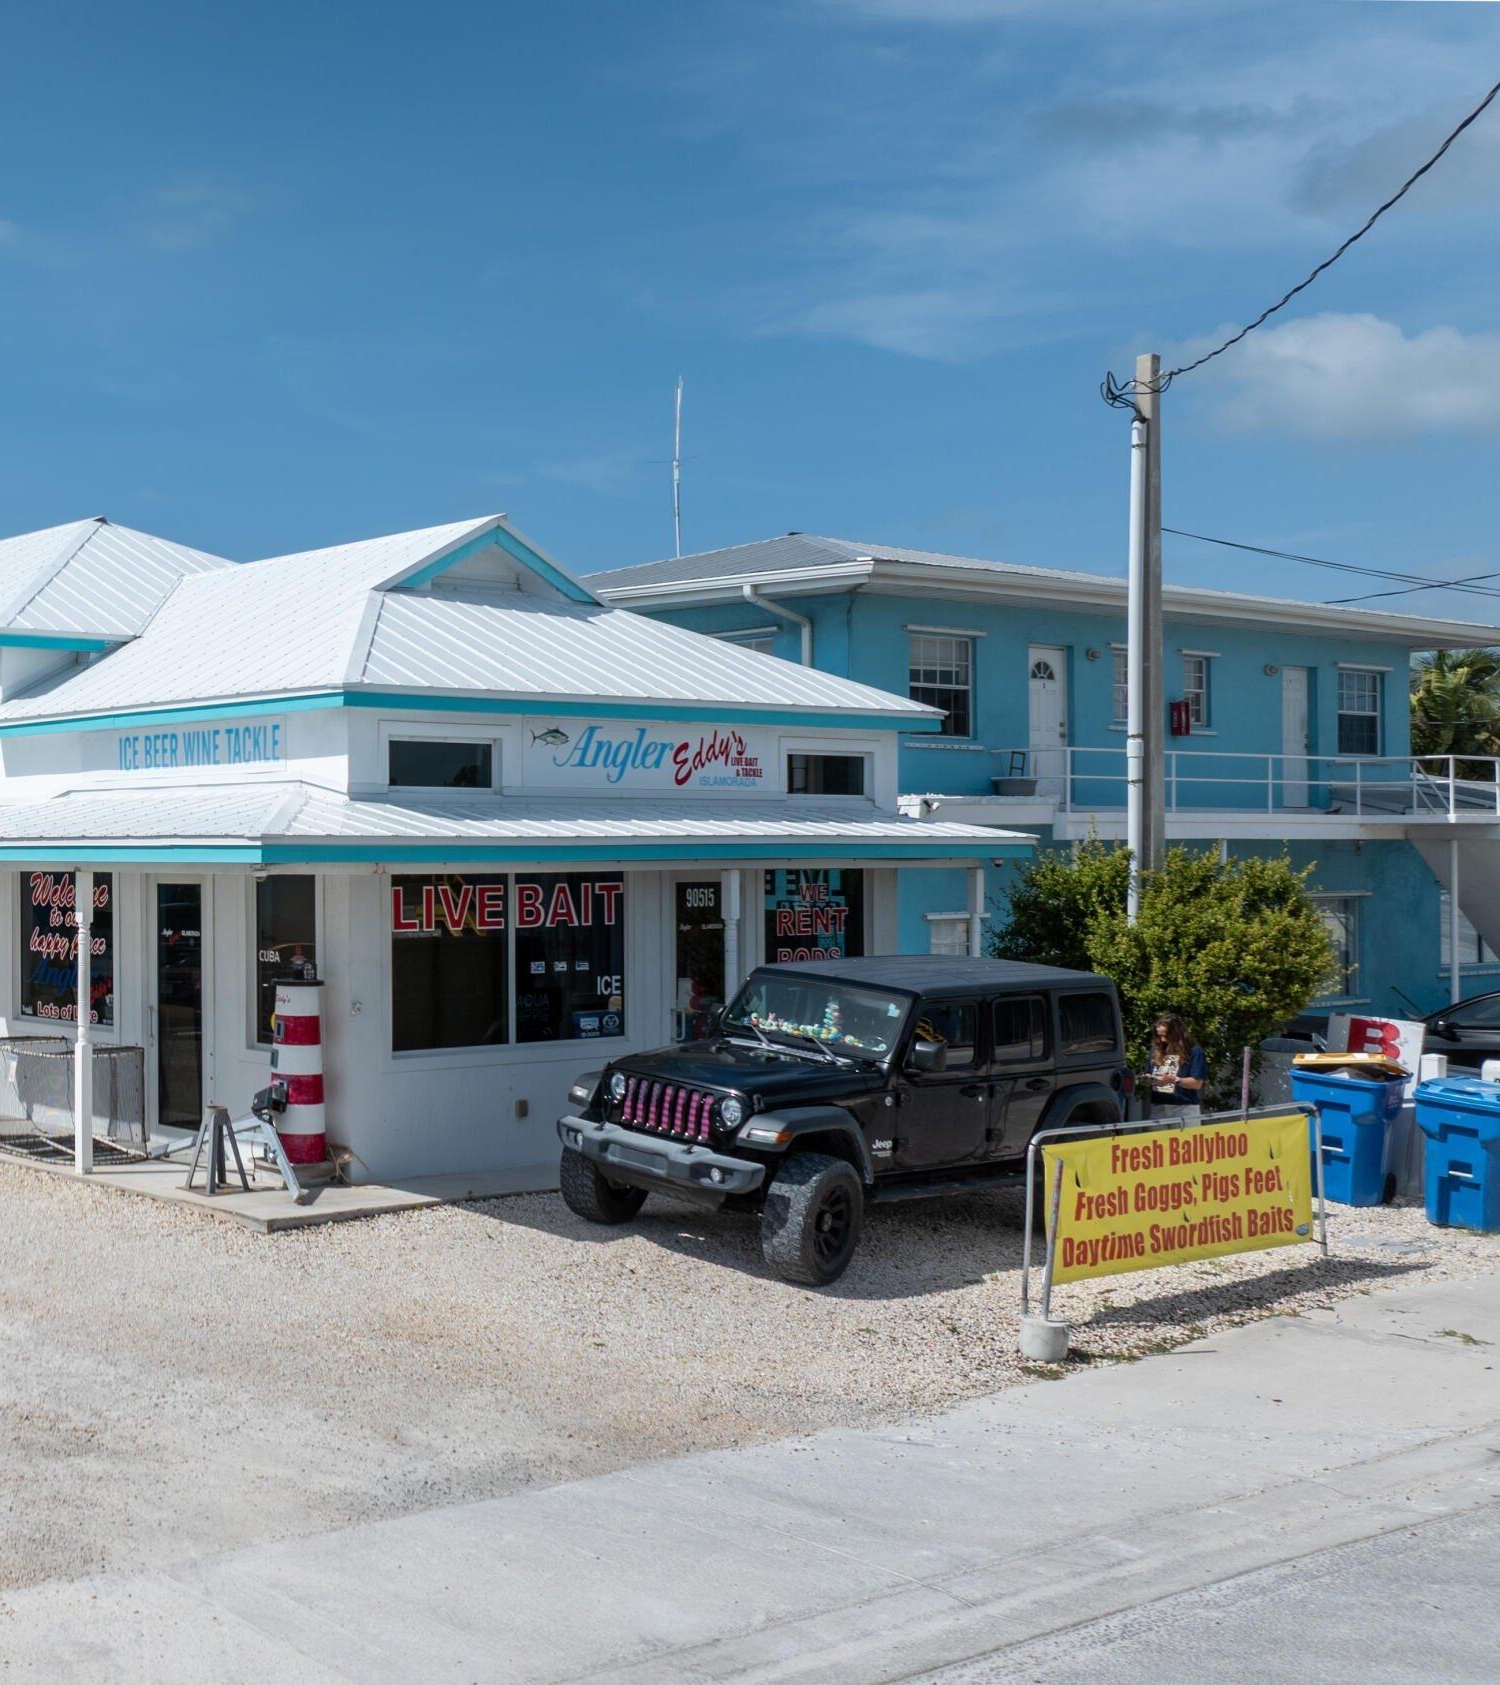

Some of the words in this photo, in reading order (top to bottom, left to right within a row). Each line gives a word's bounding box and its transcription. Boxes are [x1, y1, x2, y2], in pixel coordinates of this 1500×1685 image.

[119, 736, 139, 770] ICE
[144, 733, 178, 768] BEER
[183, 729, 220, 766] WINE
[225, 724, 280, 764] TACKLE
[553, 723, 673, 783] Angler
[672, 729, 747, 786] Eddy's
[731, 757, 743, 766] LIVE
[745, 757, 758, 767] BAIT
[742, 768, 763, 777] TACKLE
[700, 776, 757, 787] ISLAMORADA
[30, 872, 108, 907] Welce
[686, 888, 715, 908] 90515
[799, 884, 828, 902] WE
[50, 907, 63, 926] to
[392, 884, 504, 932] LIVE
[516, 882, 623, 928] BAIT
[777, 907, 848, 936] RENT
[30, 926, 69, 960] happy
[259, 950, 280, 963] CUBA
[28, 959, 98, 997] Angl
[596, 975, 621, 995] ICE
[37, 1000, 60, 1018] Lots
[60, 1003, 72, 1020] of
[73, 1005, 99, 1024] Le
[872, 1139, 893, 1150] Jeep
[1111, 1140, 1163, 1174] Fresh
[1169, 1132, 1248, 1166] Ballyhoo
[1075, 1187, 1128, 1221] Fresh
[1134, 1180, 1197, 1213] Goggs,
[1202, 1172, 1239, 1203] Pigs
[1245, 1166, 1283, 1195] Feet
[1062, 1231, 1145, 1268] Daytime
[1150, 1212, 1242, 1254] Swordfish
[1247, 1207, 1294, 1237] Baits
